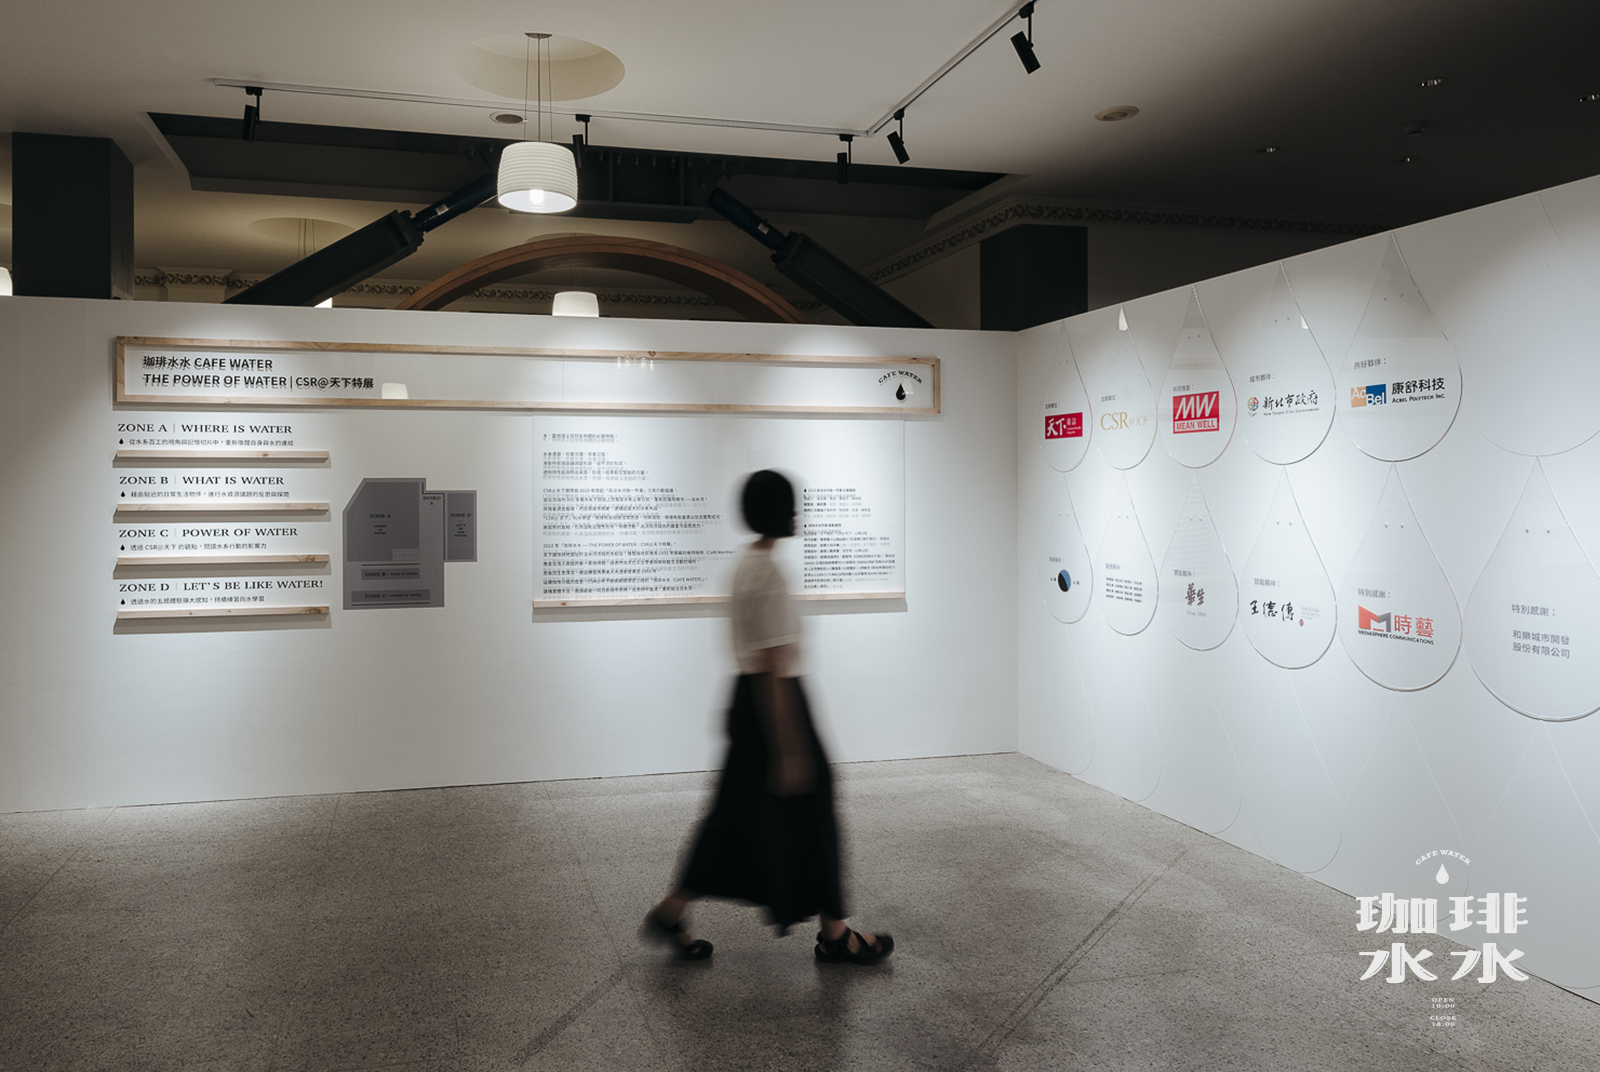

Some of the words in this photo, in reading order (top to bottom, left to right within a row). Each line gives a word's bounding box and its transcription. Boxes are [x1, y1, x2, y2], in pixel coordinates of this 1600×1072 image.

[142, 355, 191, 368] 珈琲水水
[194, 357, 226, 368] CAFE
[229, 358, 273, 369] WATER
[143, 374, 170, 384] THE
[173, 374, 220, 385] POWER
[223, 375, 241, 386] OF
[243, 376, 287, 387] WATER
[878, 371, 897, 383] CAFE
[898, 370, 923, 384] WATER
[1391, 377, 1446, 395] 康舒科技
[1174, 393, 1217, 420] MW
[1262, 389, 1319, 411] 新北市政府
[117, 423, 155, 433] ZONE
[158, 424, 168, 433] A
[181, 424, 229, 433] WHERE
[233, 425, 245, 433] IS
[249, 425, 292, 434] WATER
[1176, 422, 1195, 431] MEAN
[1197, 419, 1215, 429] WELL
[119, 476, 157, 485] ZONE
[160, 476, 169, 485] B
[182, 476, 221, 485] WHAT
[225, 476, 237, 485] IS
[240, 476, 285, 485] WATER
[118, 529, 156, 538] ZONE
[160, 529, 169, 538] C
[182, 528, 230, 537] POWER
[233, 528, 251, 537] OF
[255, 528, 298, 537] WATER
[119, 583, 157, 592] ZONE
[160, 583, 170, 592] D
[224, 581, 241, 590] BE
[244, 581, 273, 590] LIKE
[277, 580, 324, 589] WATER!
[1250, 600, 1295, 622] 王德傳
[1394, 614, 1434, 639] 時藝
[1388, 634, 1435, 645] COMMUNICATIONS
[1512, 629, 1570, 646] 和樂城市開發
[1512, 642, 1570, 659] 股份有限公司
